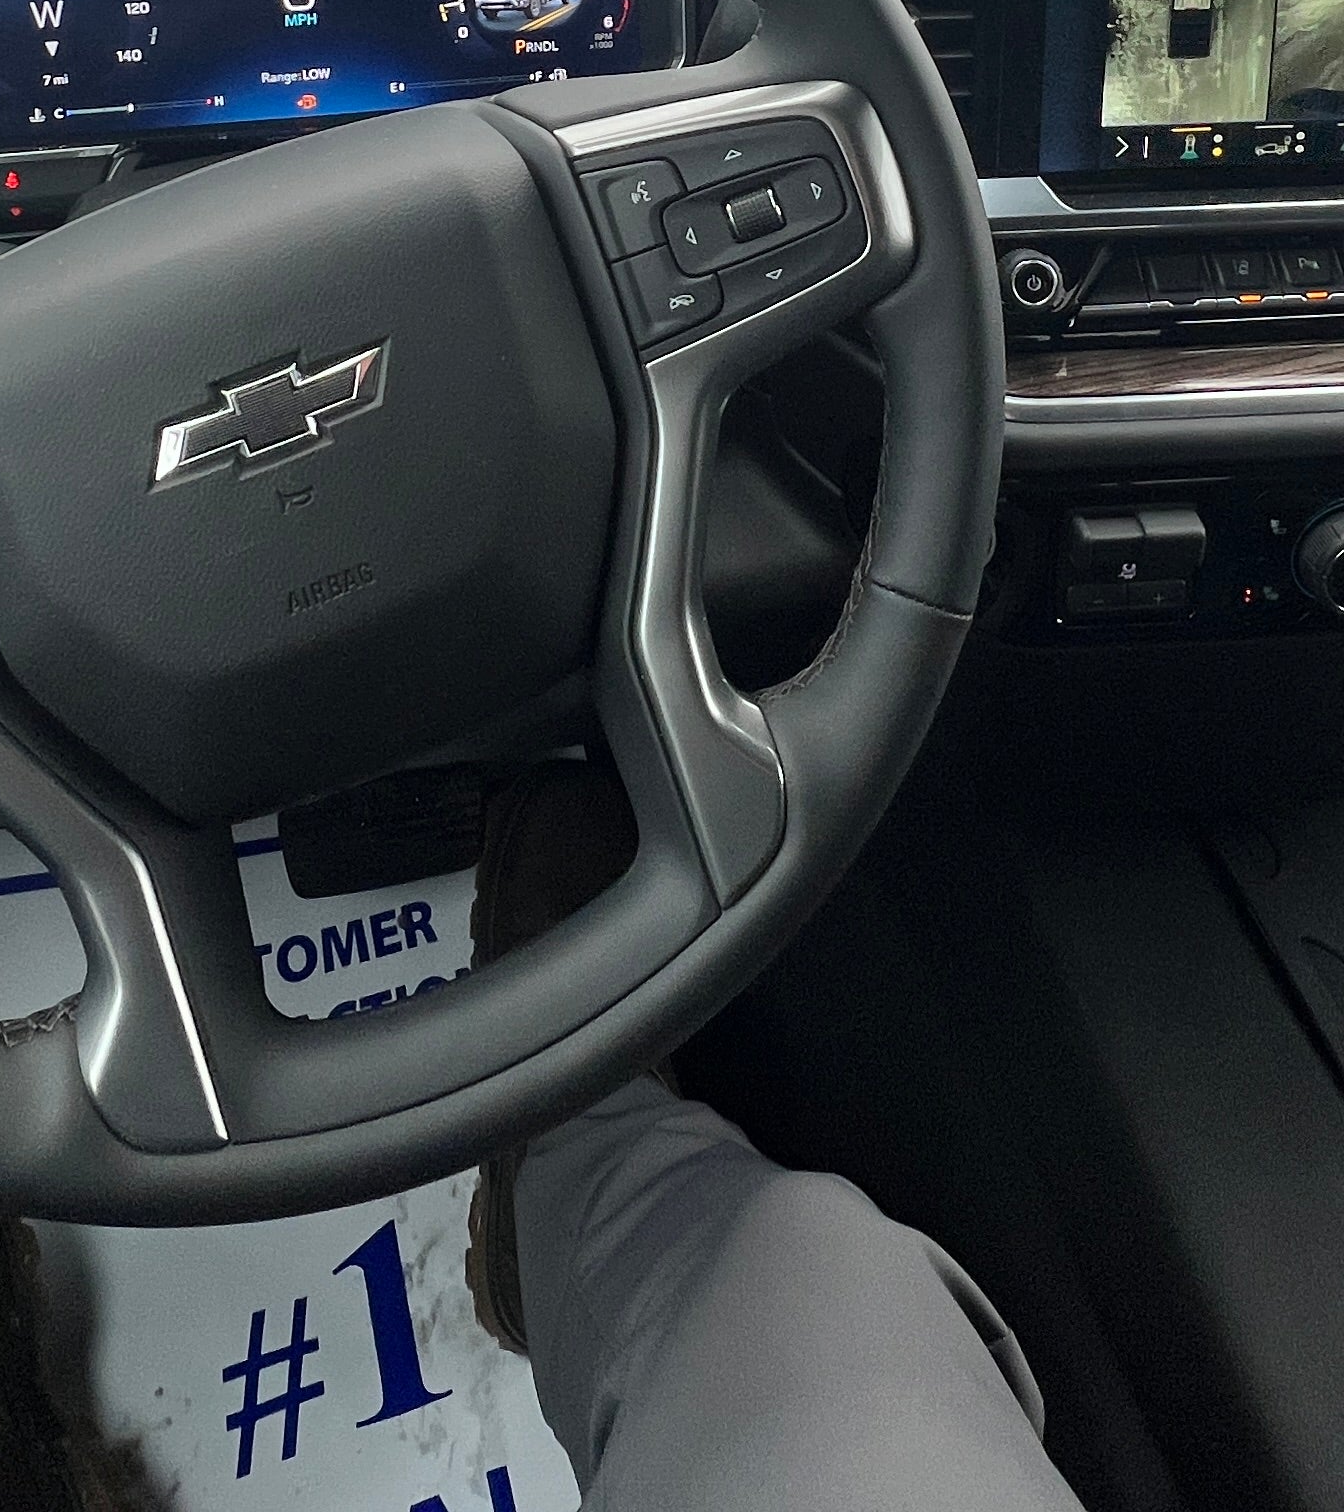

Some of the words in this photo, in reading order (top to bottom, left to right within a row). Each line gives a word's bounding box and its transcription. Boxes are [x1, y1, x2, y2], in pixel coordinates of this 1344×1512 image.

[29, 0, 64, 29] W
[125, 1, 151, 15] 120
[284, 13, 318, 27] MPH
[603, 16, 614, 28] 6
[458, 27, 468, 38] 0
[515, 40, 559, 54] PRNDL
[116, 48, 143, 63] 140
[43, 75, 51, 86] 7
[53, 73, 69, 85] mi
[390, 82, 398, 93] E
[215, 95, 224, 106] H
[53, 107, 64, 119] C
[287, 562, 375, 615] AIRBAG
[222, 1219, 453, 1479] #1
